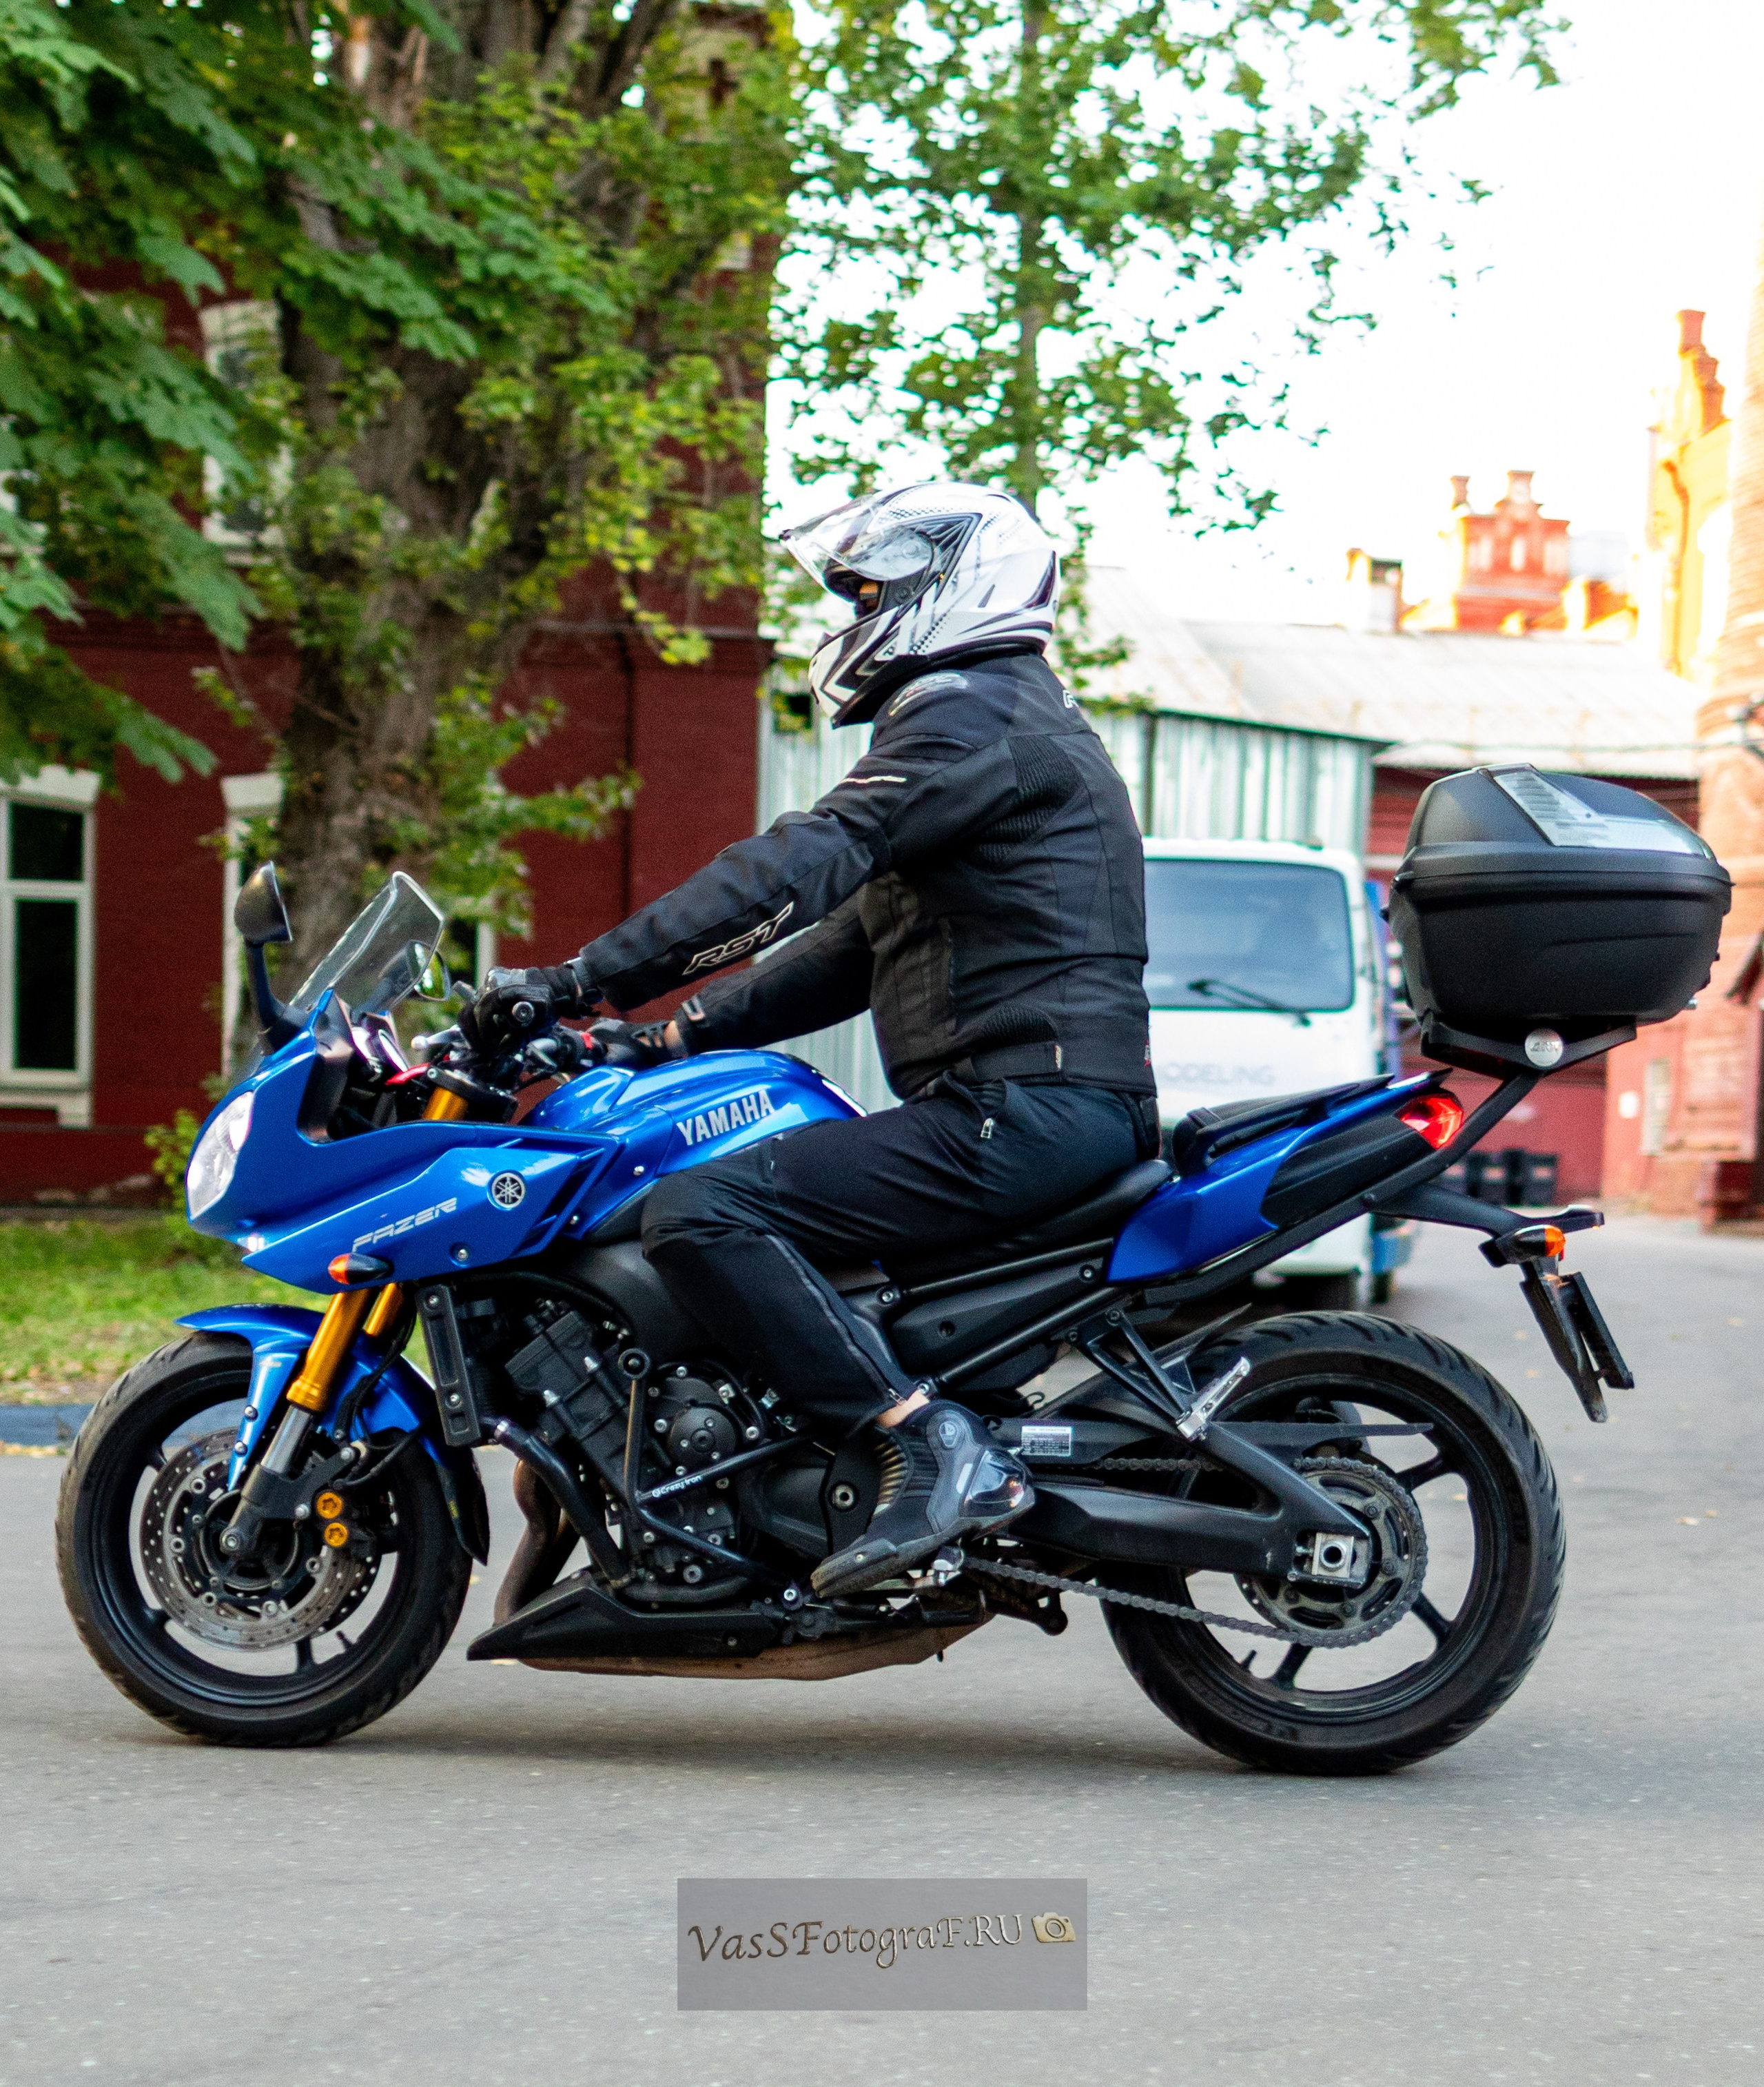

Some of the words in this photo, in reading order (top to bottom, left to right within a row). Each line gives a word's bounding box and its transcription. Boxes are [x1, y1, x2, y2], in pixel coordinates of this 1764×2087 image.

[676, 1089, 775, 1146] YAMAHA
[352, 1197, 457, 1253] FAZER
[661, 1481, 685, 1494] Crazy
